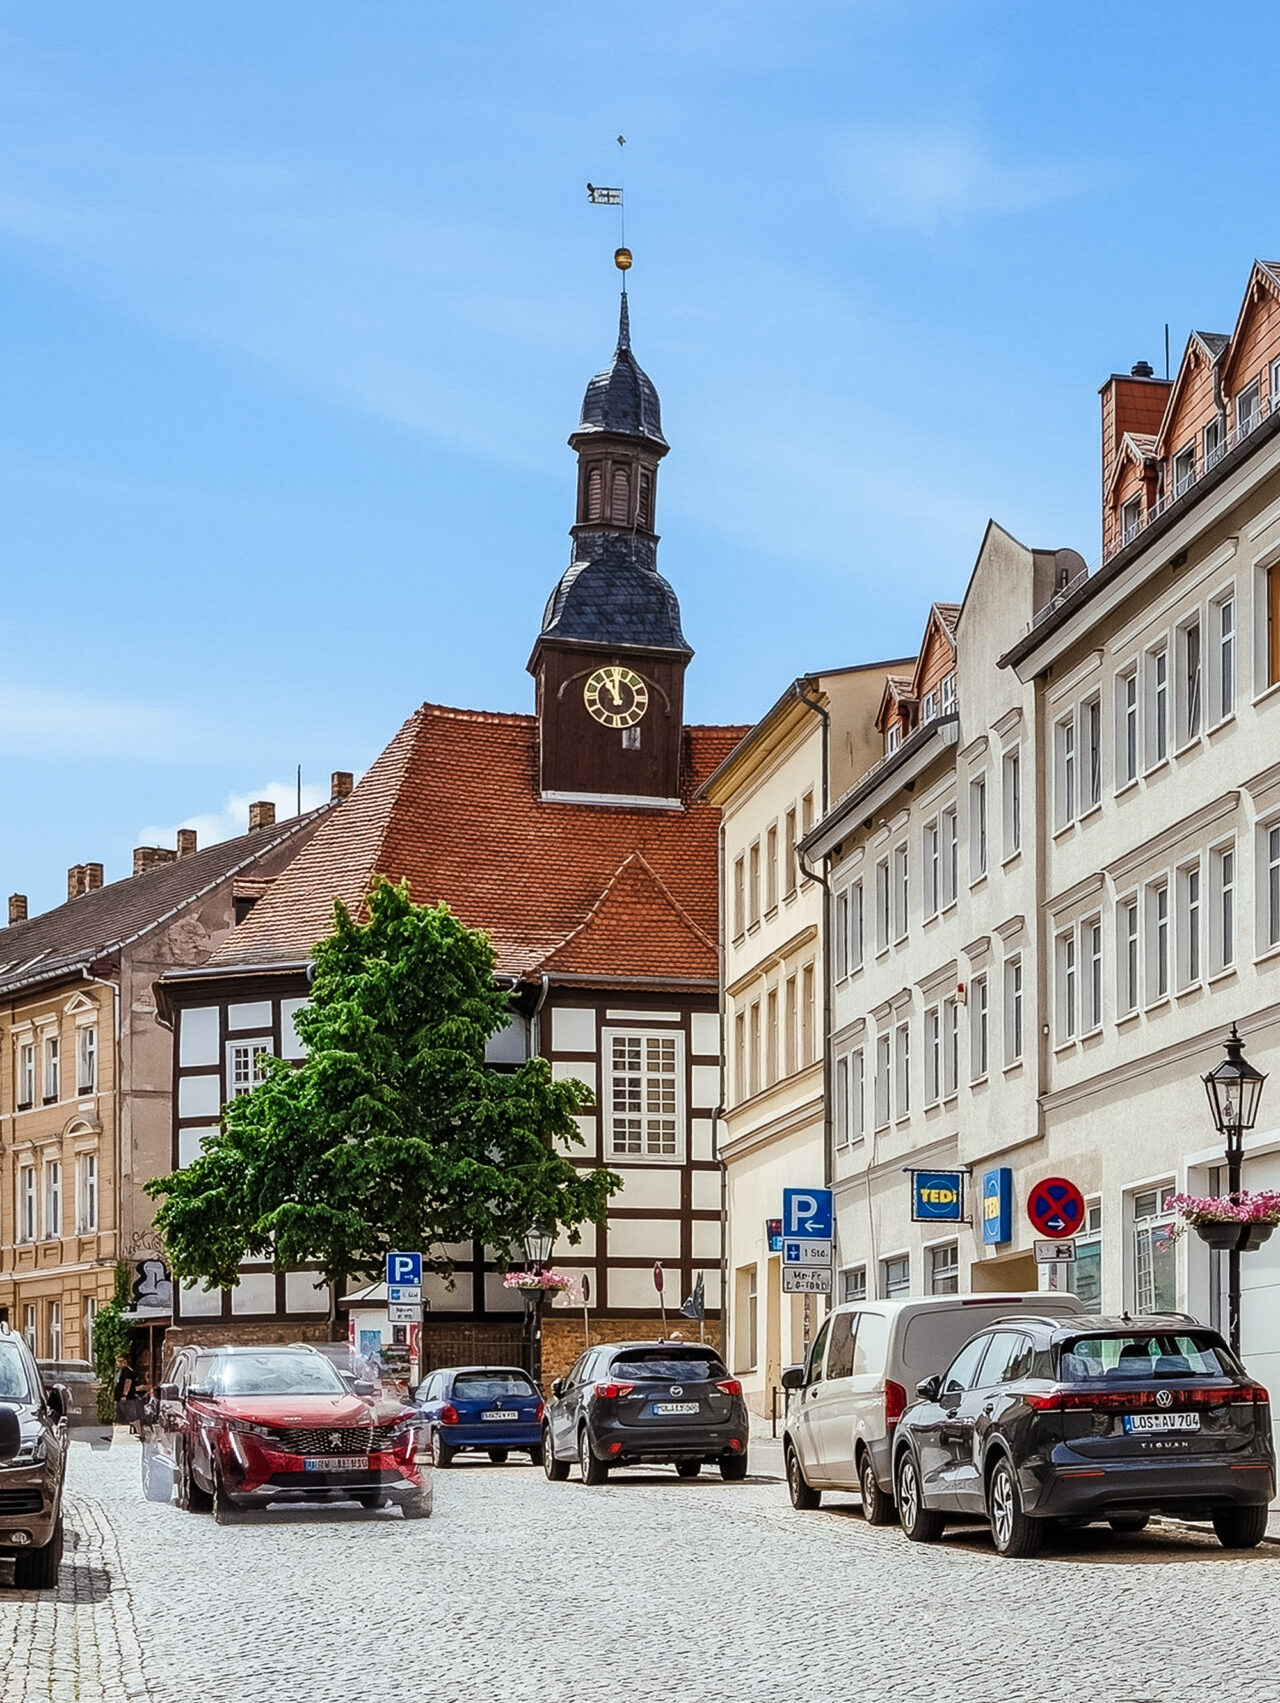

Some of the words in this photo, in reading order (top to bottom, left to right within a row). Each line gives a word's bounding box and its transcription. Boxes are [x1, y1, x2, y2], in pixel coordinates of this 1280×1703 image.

[920, 1188, 957, 1204] TEDi
[791, 1194, 818, 1232] P
[804, 1248, 808, 1257] 1
[811, 1248, 828, 1258] Std.
[395, 1256, 413, 1281] P
[1132, 1415, 1153, 1429] LOS
[1162, 1414, 1175, 1427] AV
[1178, 1413, 1198, 1427] 704
[1141, 1441, 1188, 1449] TIGUAN
